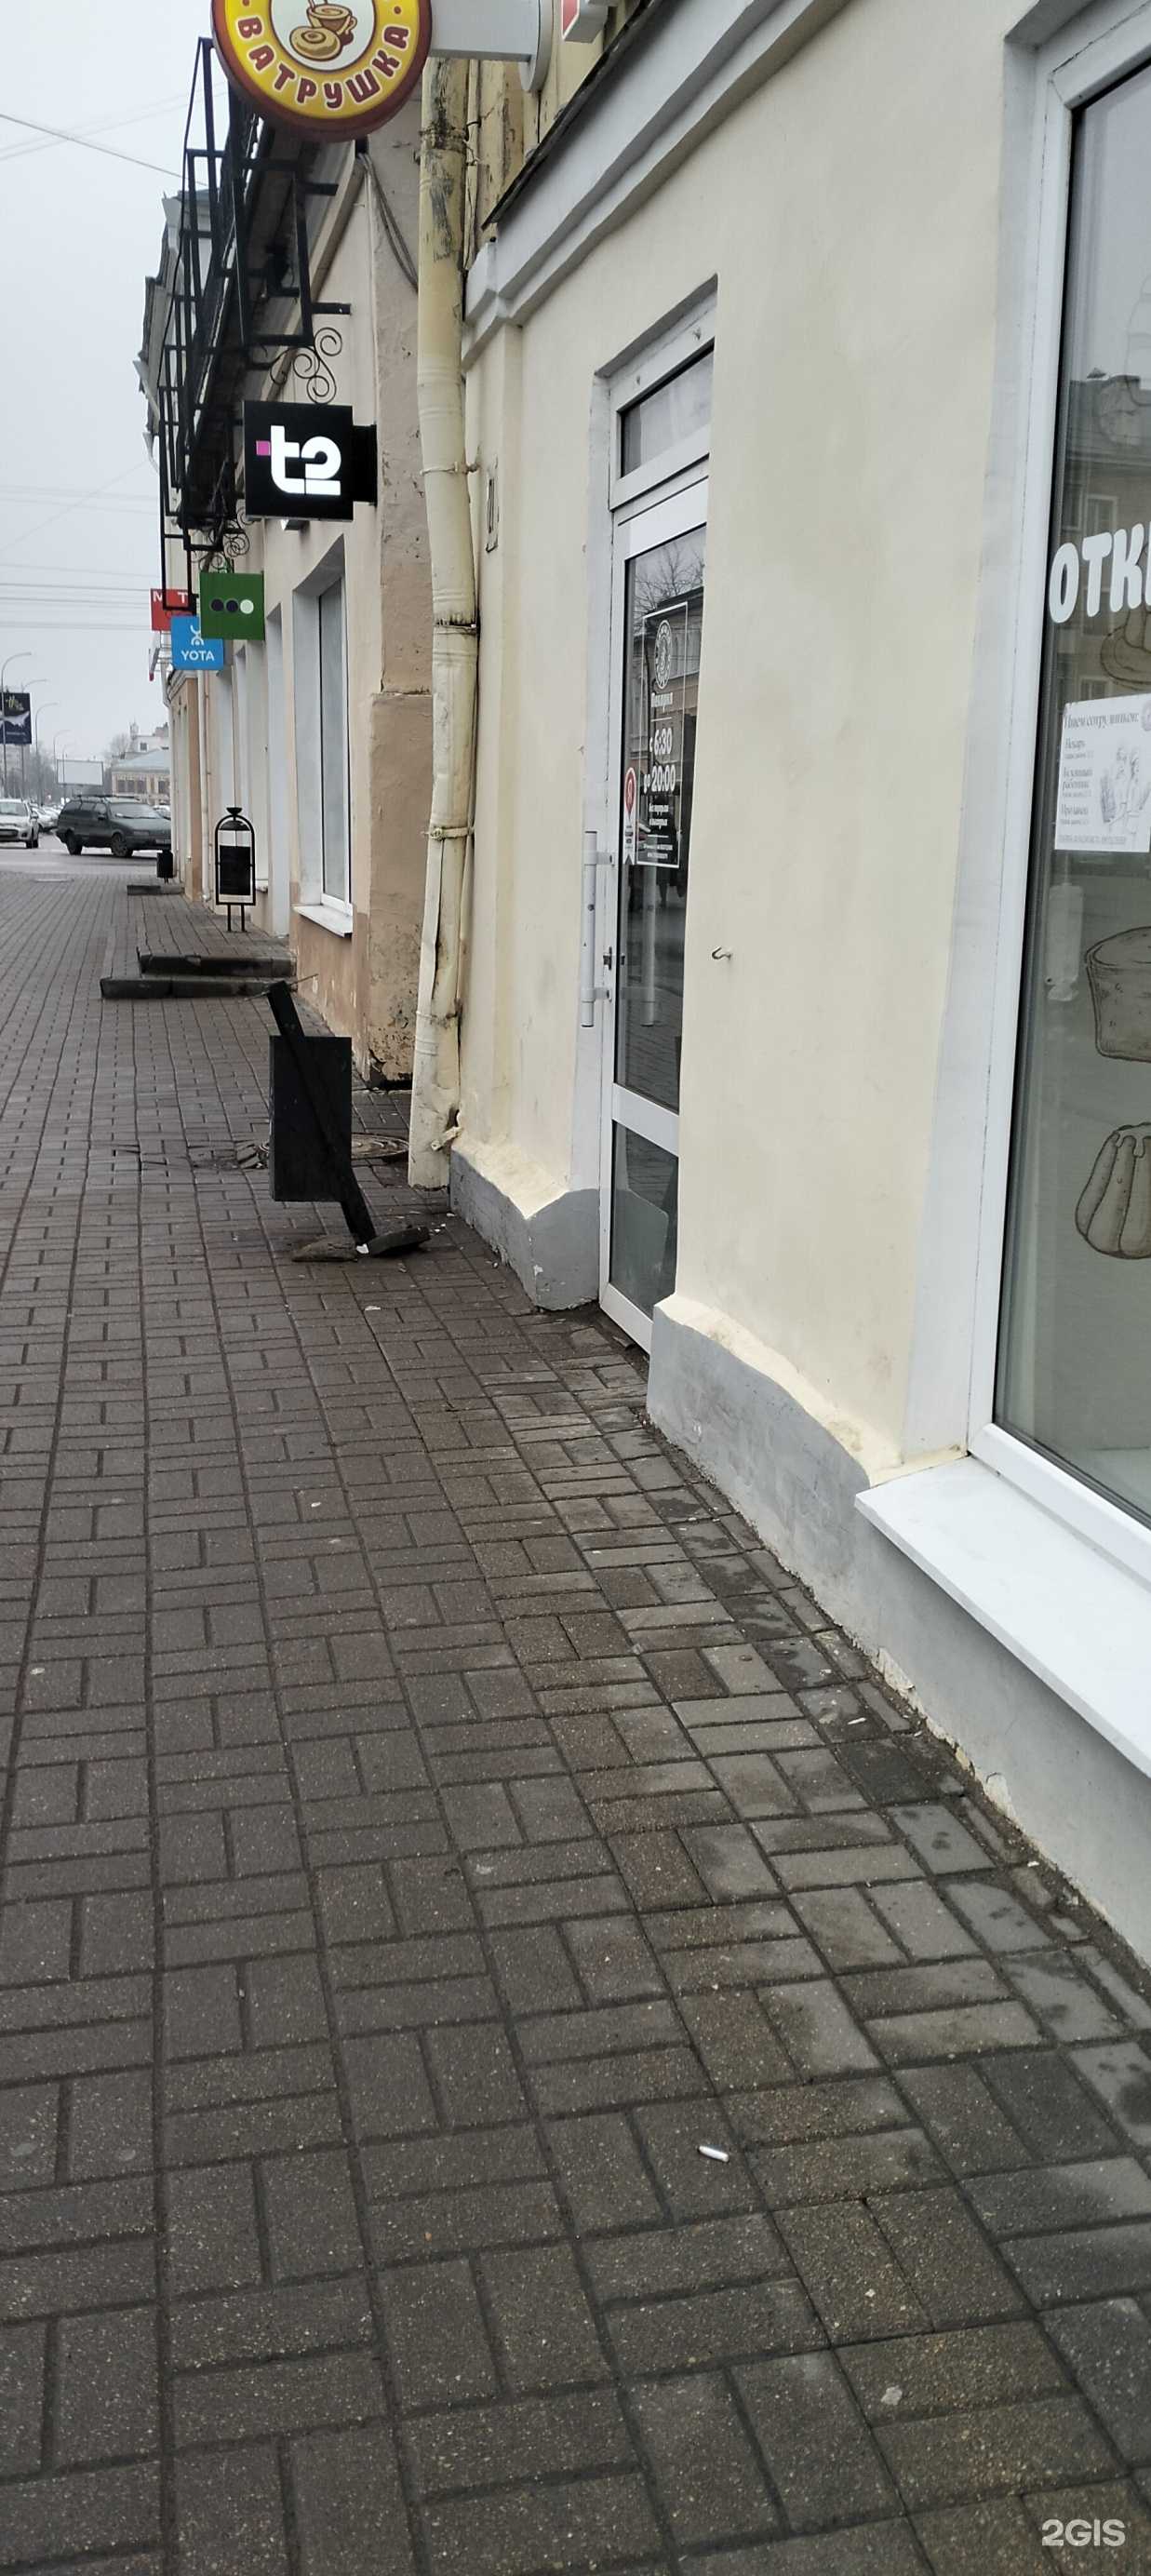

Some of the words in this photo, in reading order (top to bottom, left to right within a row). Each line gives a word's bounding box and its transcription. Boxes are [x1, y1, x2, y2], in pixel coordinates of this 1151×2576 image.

[235, 16, 409, 109] ВАТРУШКА
[256, 425, 341, 496] t2
[1049, 521, 1151, 624] ОТК
[181, 650, 215, 662] YOTA
[654, 728, 672, 756] 6:30
[651, 765, 676, 792] 20:00
